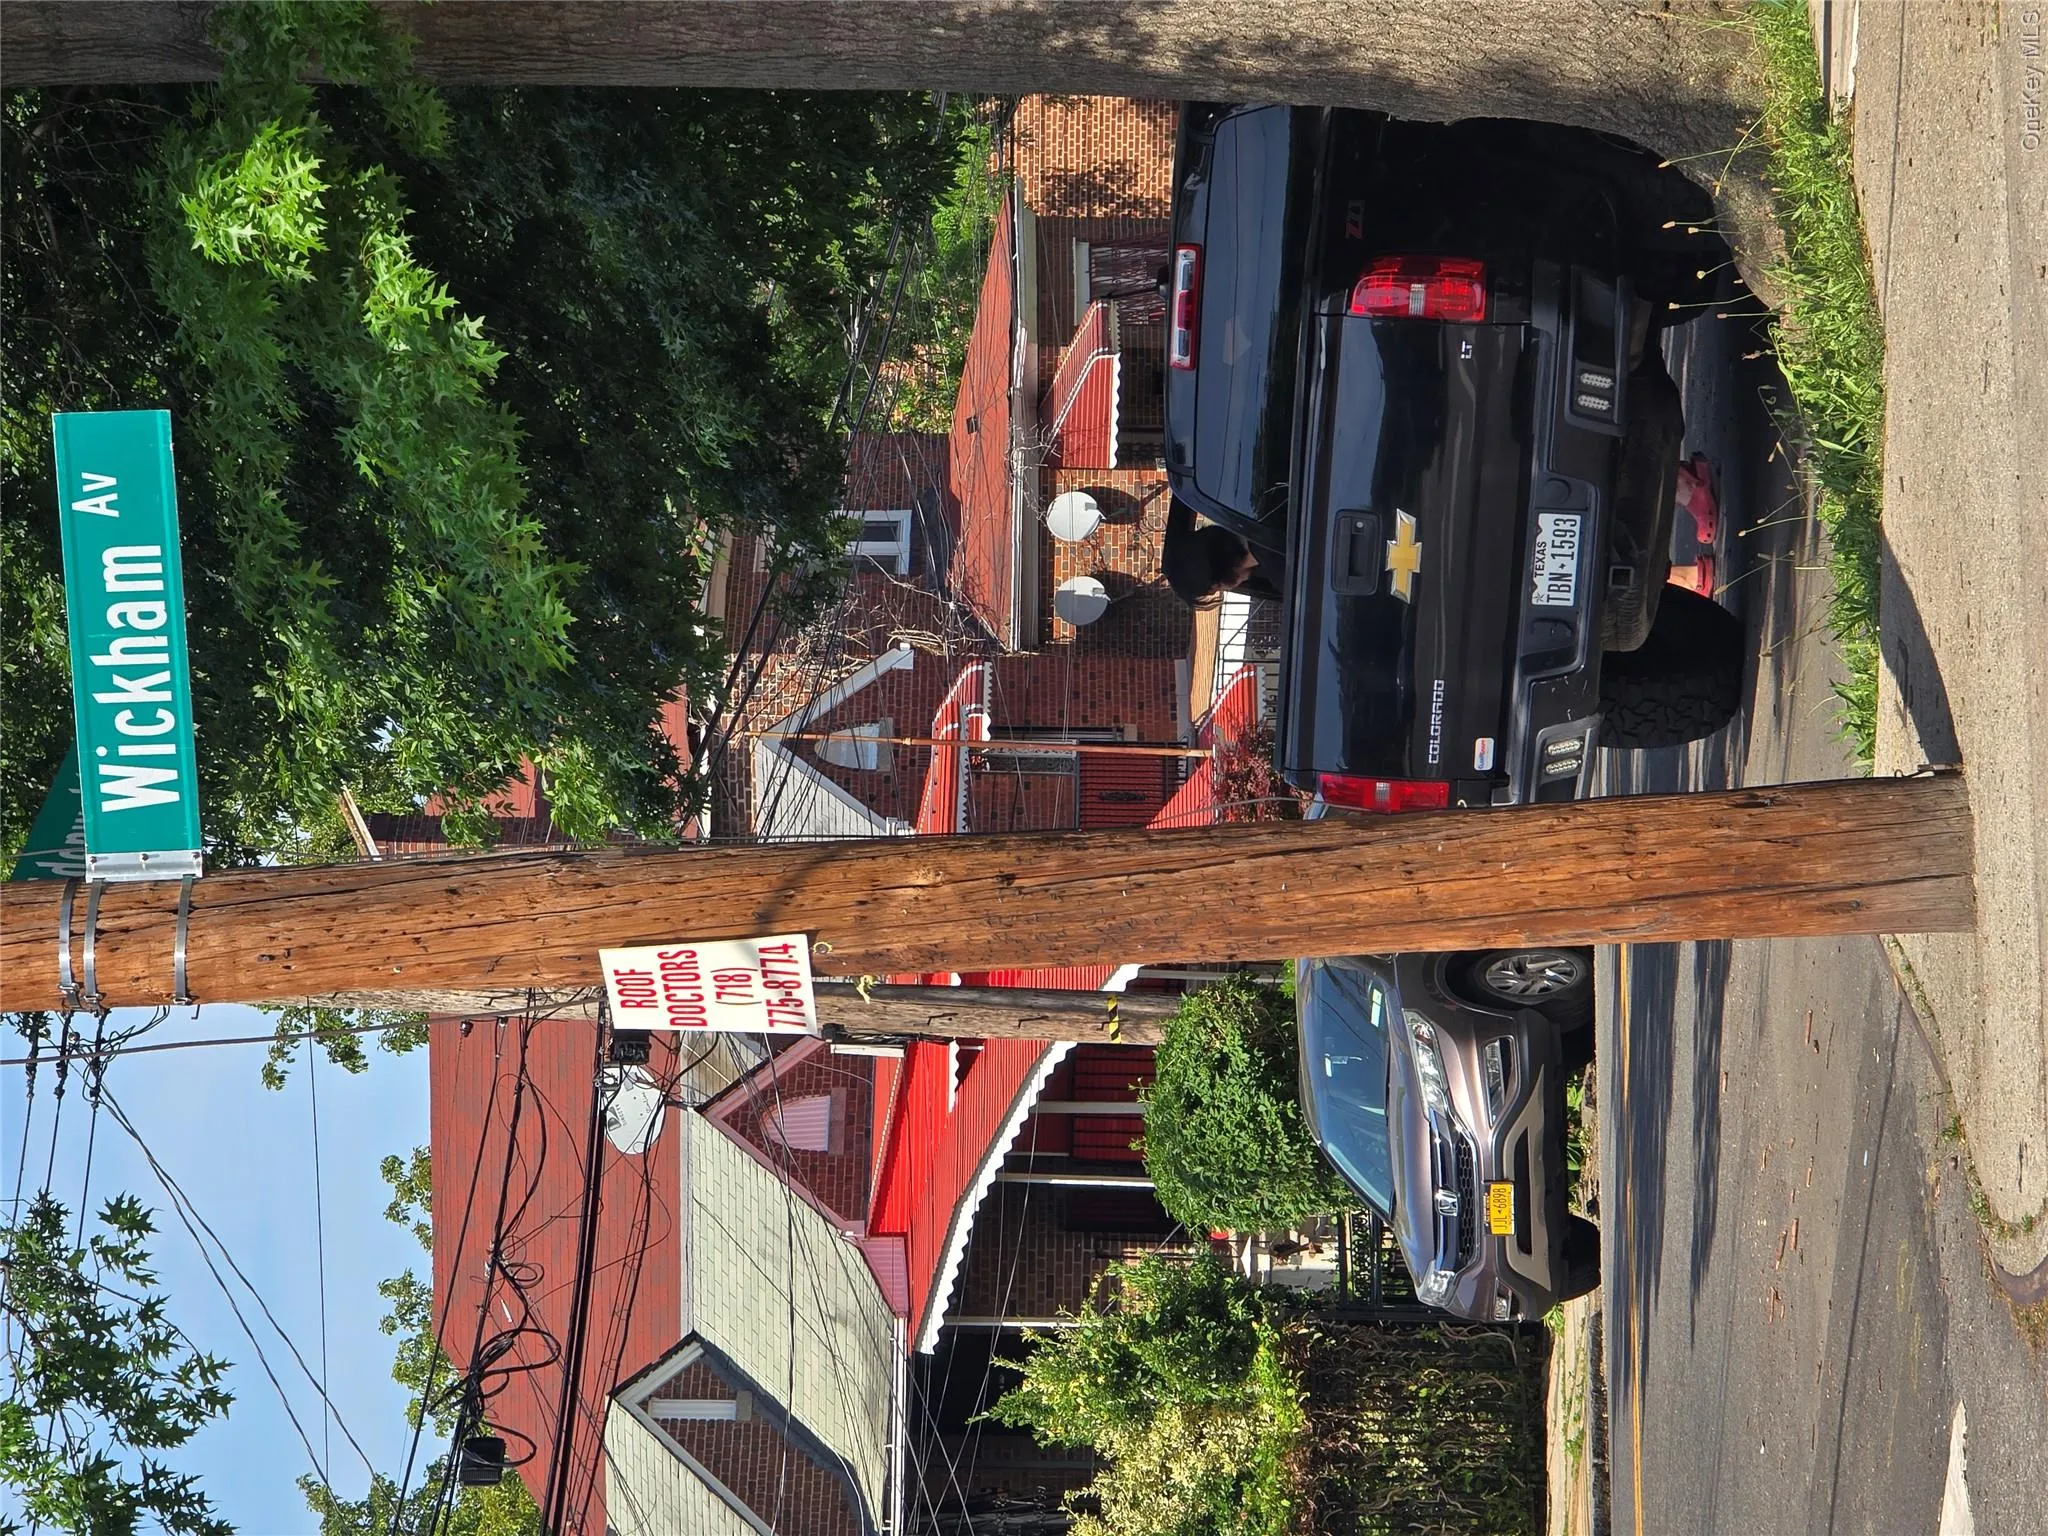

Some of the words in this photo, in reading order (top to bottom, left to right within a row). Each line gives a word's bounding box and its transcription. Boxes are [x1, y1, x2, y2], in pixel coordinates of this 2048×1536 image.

[1460, 340, 1473, 359] LT
[71, 471, 120, 519] Av
[1534, 541, 1547, 578] TEXAS
[89, 545, 181, 813] Wickham
[1428, 679, 1445, 764] COLORADO
[613, 968, 659, 1008] ROOF
[657, 949, 708, 1027] DOCTORS
[709, 967, 763, 1006] (718)
[758, 943, 807, 1028] 775-8774
